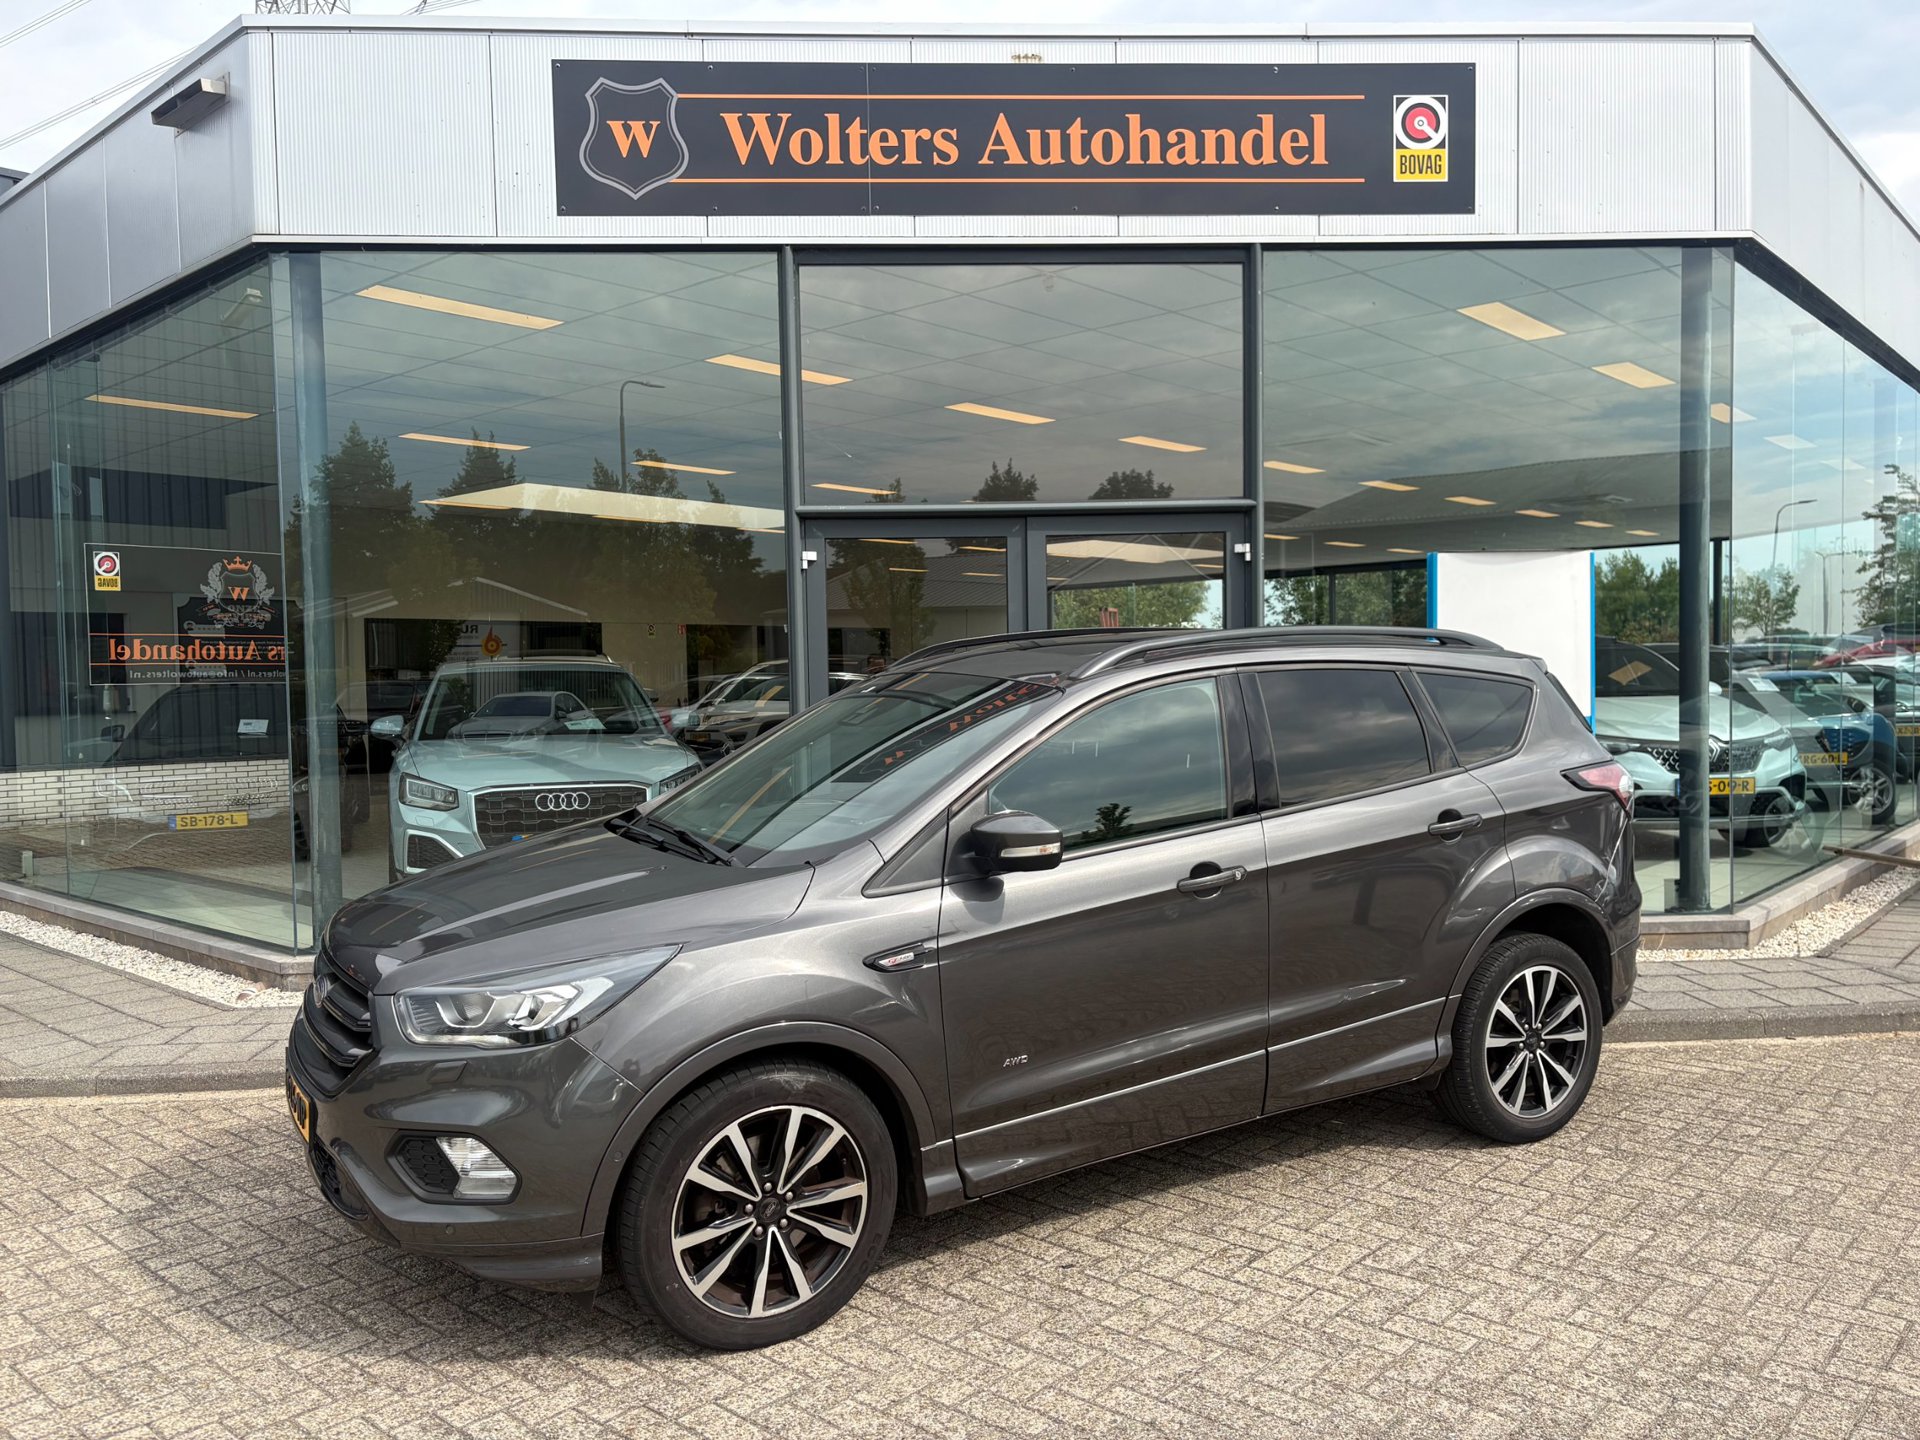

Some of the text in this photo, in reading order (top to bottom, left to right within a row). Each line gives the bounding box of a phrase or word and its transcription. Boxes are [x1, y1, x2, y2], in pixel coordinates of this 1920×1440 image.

[606, 120, 661, 158] W
[720, 112, 1329, 166] Wolters Autohandel
[1399, 154, 1442, 175] BOVAG
[180, 814, 239, 828] SB-178-L
[1002, 1054, 1029, 1068] AWD
